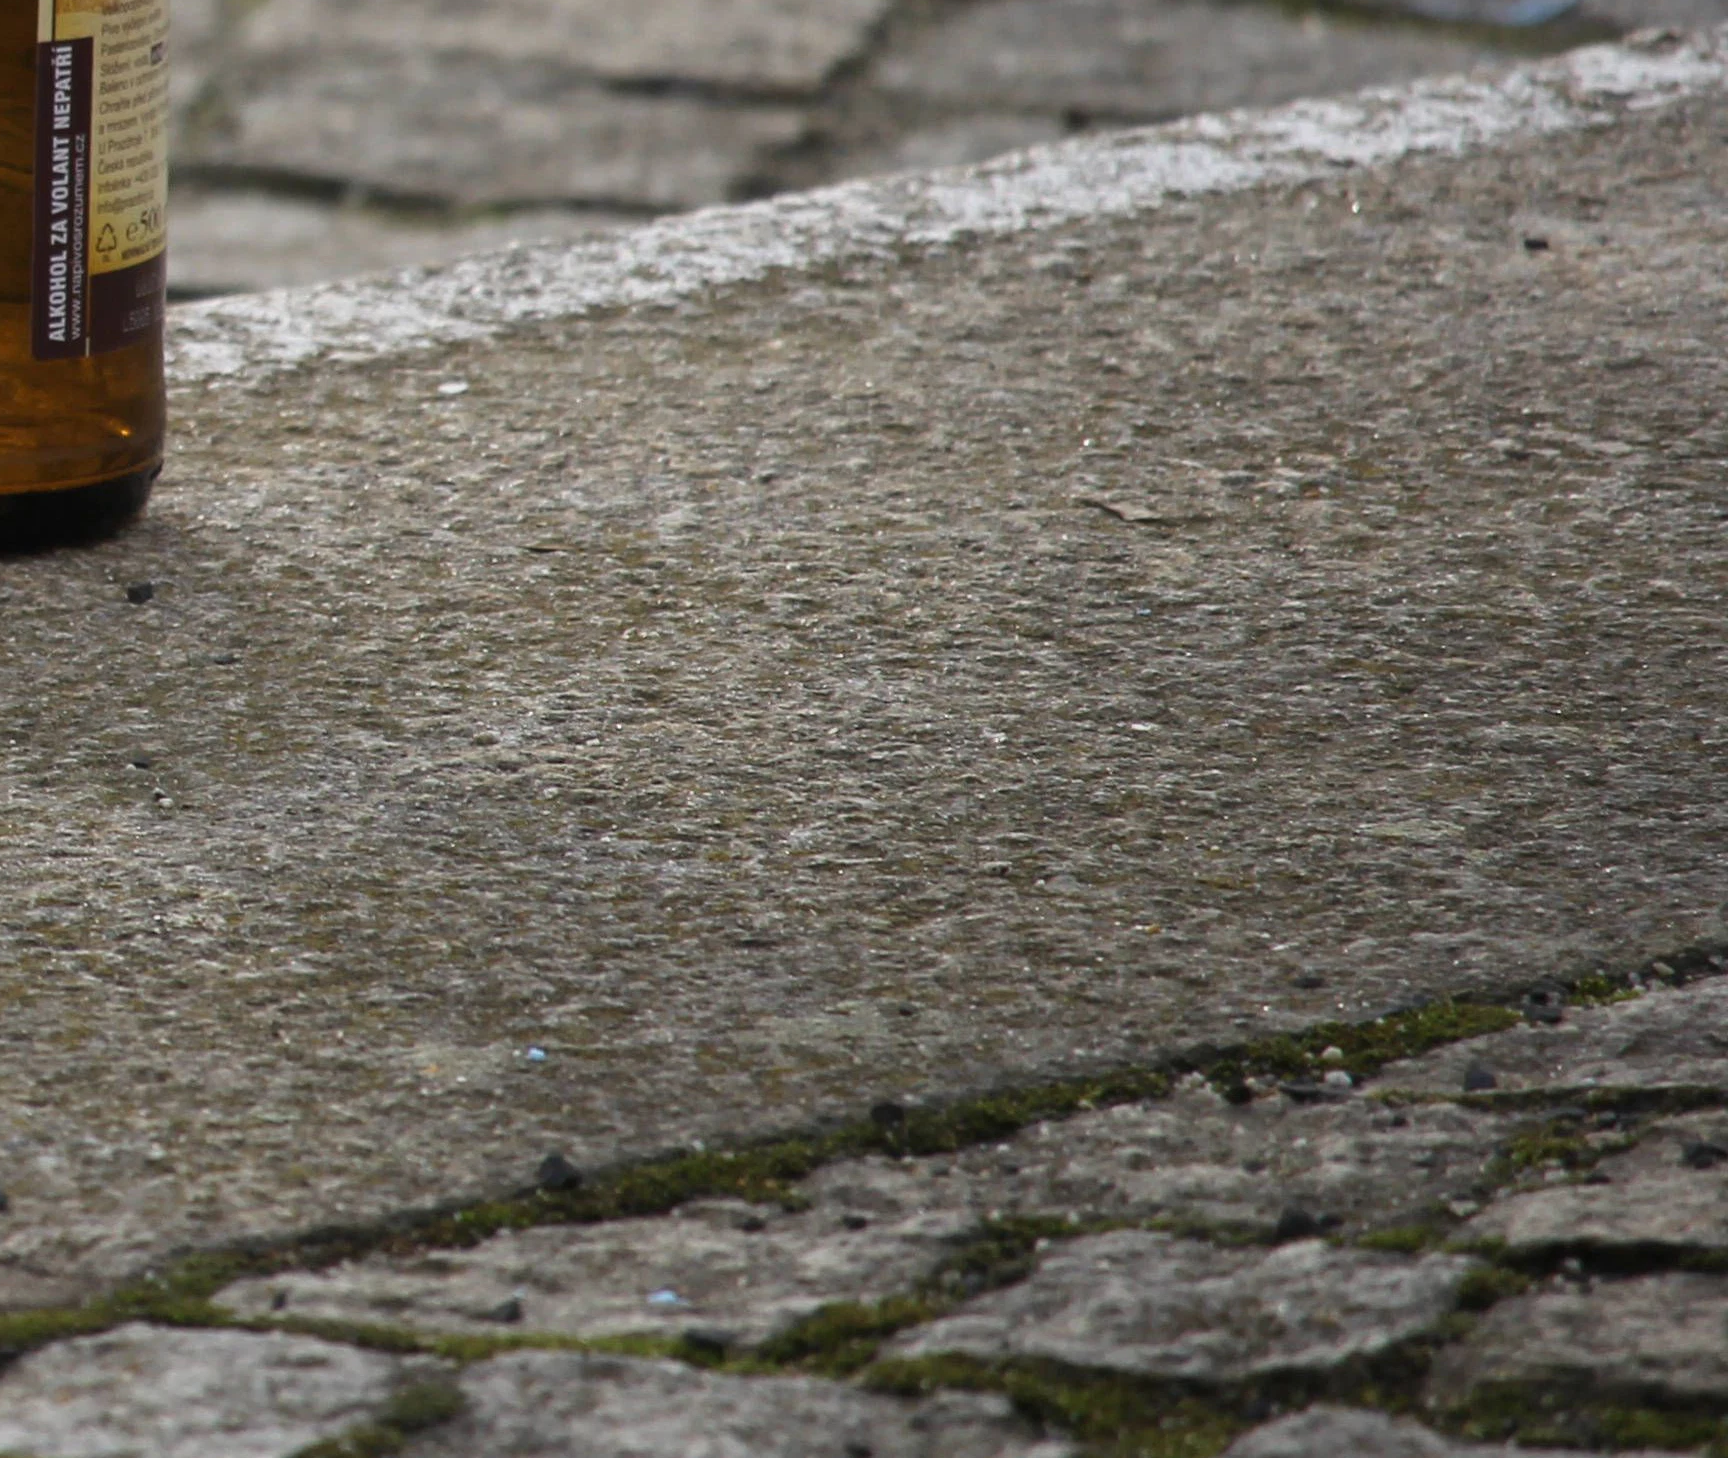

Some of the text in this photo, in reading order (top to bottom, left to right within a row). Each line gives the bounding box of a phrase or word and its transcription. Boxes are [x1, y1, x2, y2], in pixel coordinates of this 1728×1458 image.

[48, 45, 74, 342] ALKOHOL ZA VOLANT NEPATŘÍ
